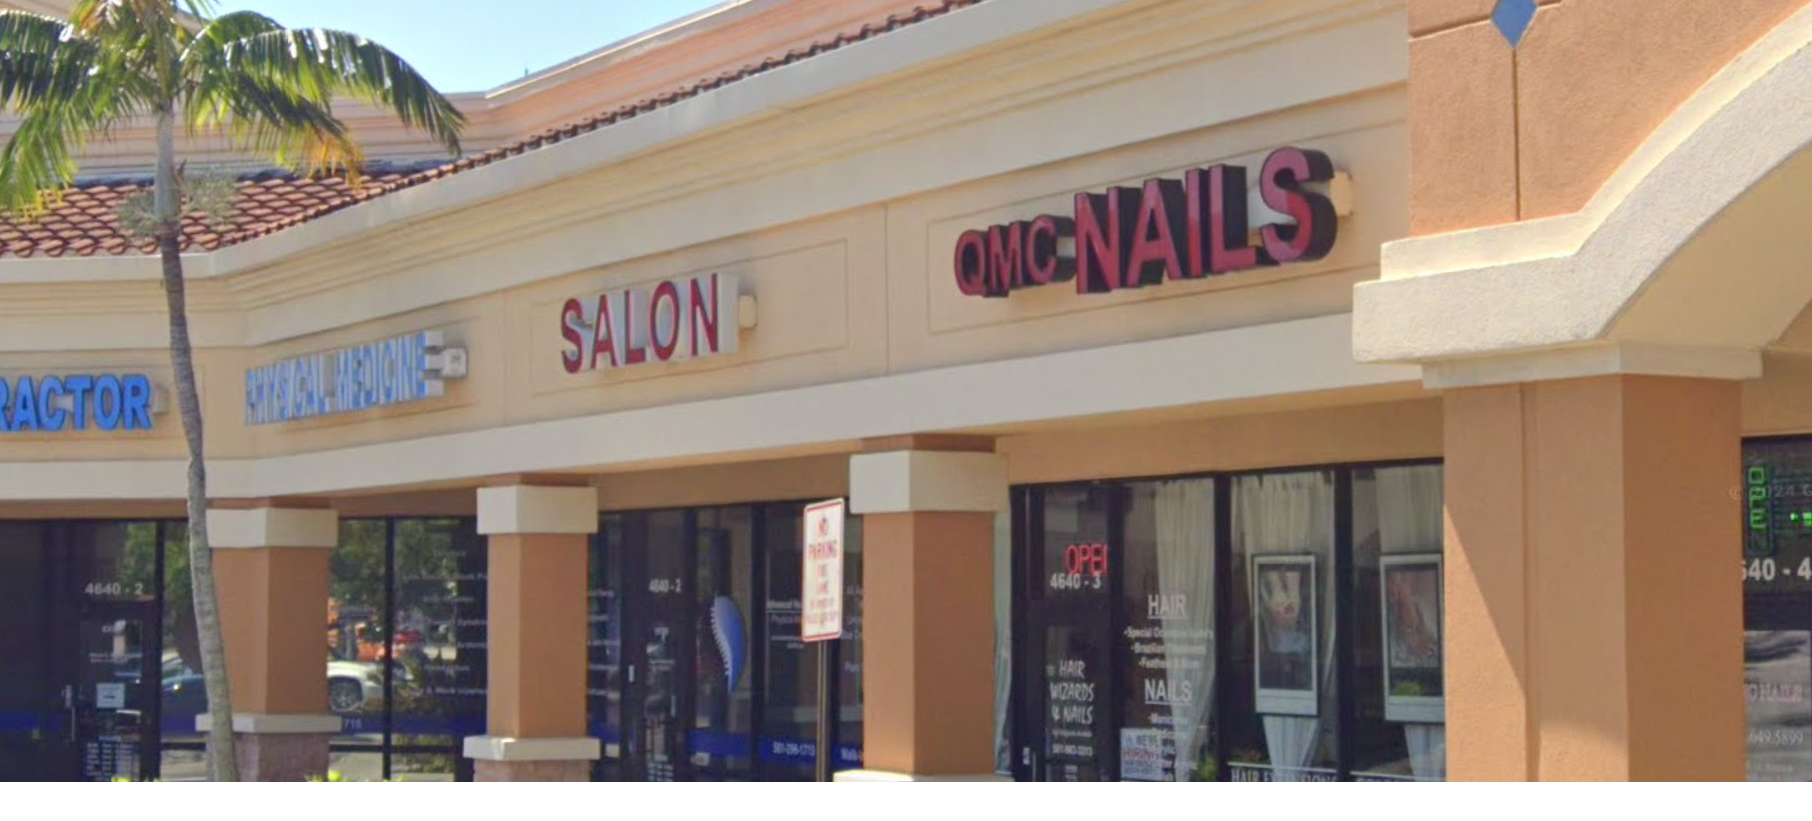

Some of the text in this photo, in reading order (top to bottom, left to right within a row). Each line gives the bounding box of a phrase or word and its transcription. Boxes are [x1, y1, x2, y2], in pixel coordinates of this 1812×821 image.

[954, 146, 1332, 298] QMC NAILS
[561, 273, 722, 374] SALON
[245, 332, 427, 426] PHYSICAL MEDICINE
[85, 582, 121, 595] 4640
[134, 583, 143, 595] 2
[1050, 573, 1080, 589] 4640
[1147, 594, 1188, 617] HAIR
[1058, 660, 1085, 679] HAIR
[1050, 682, 1094, 702] WIZARDS
[1145, 679, 1192, 701] NAILS
[1063, 705, 1093, 725] NAILS
